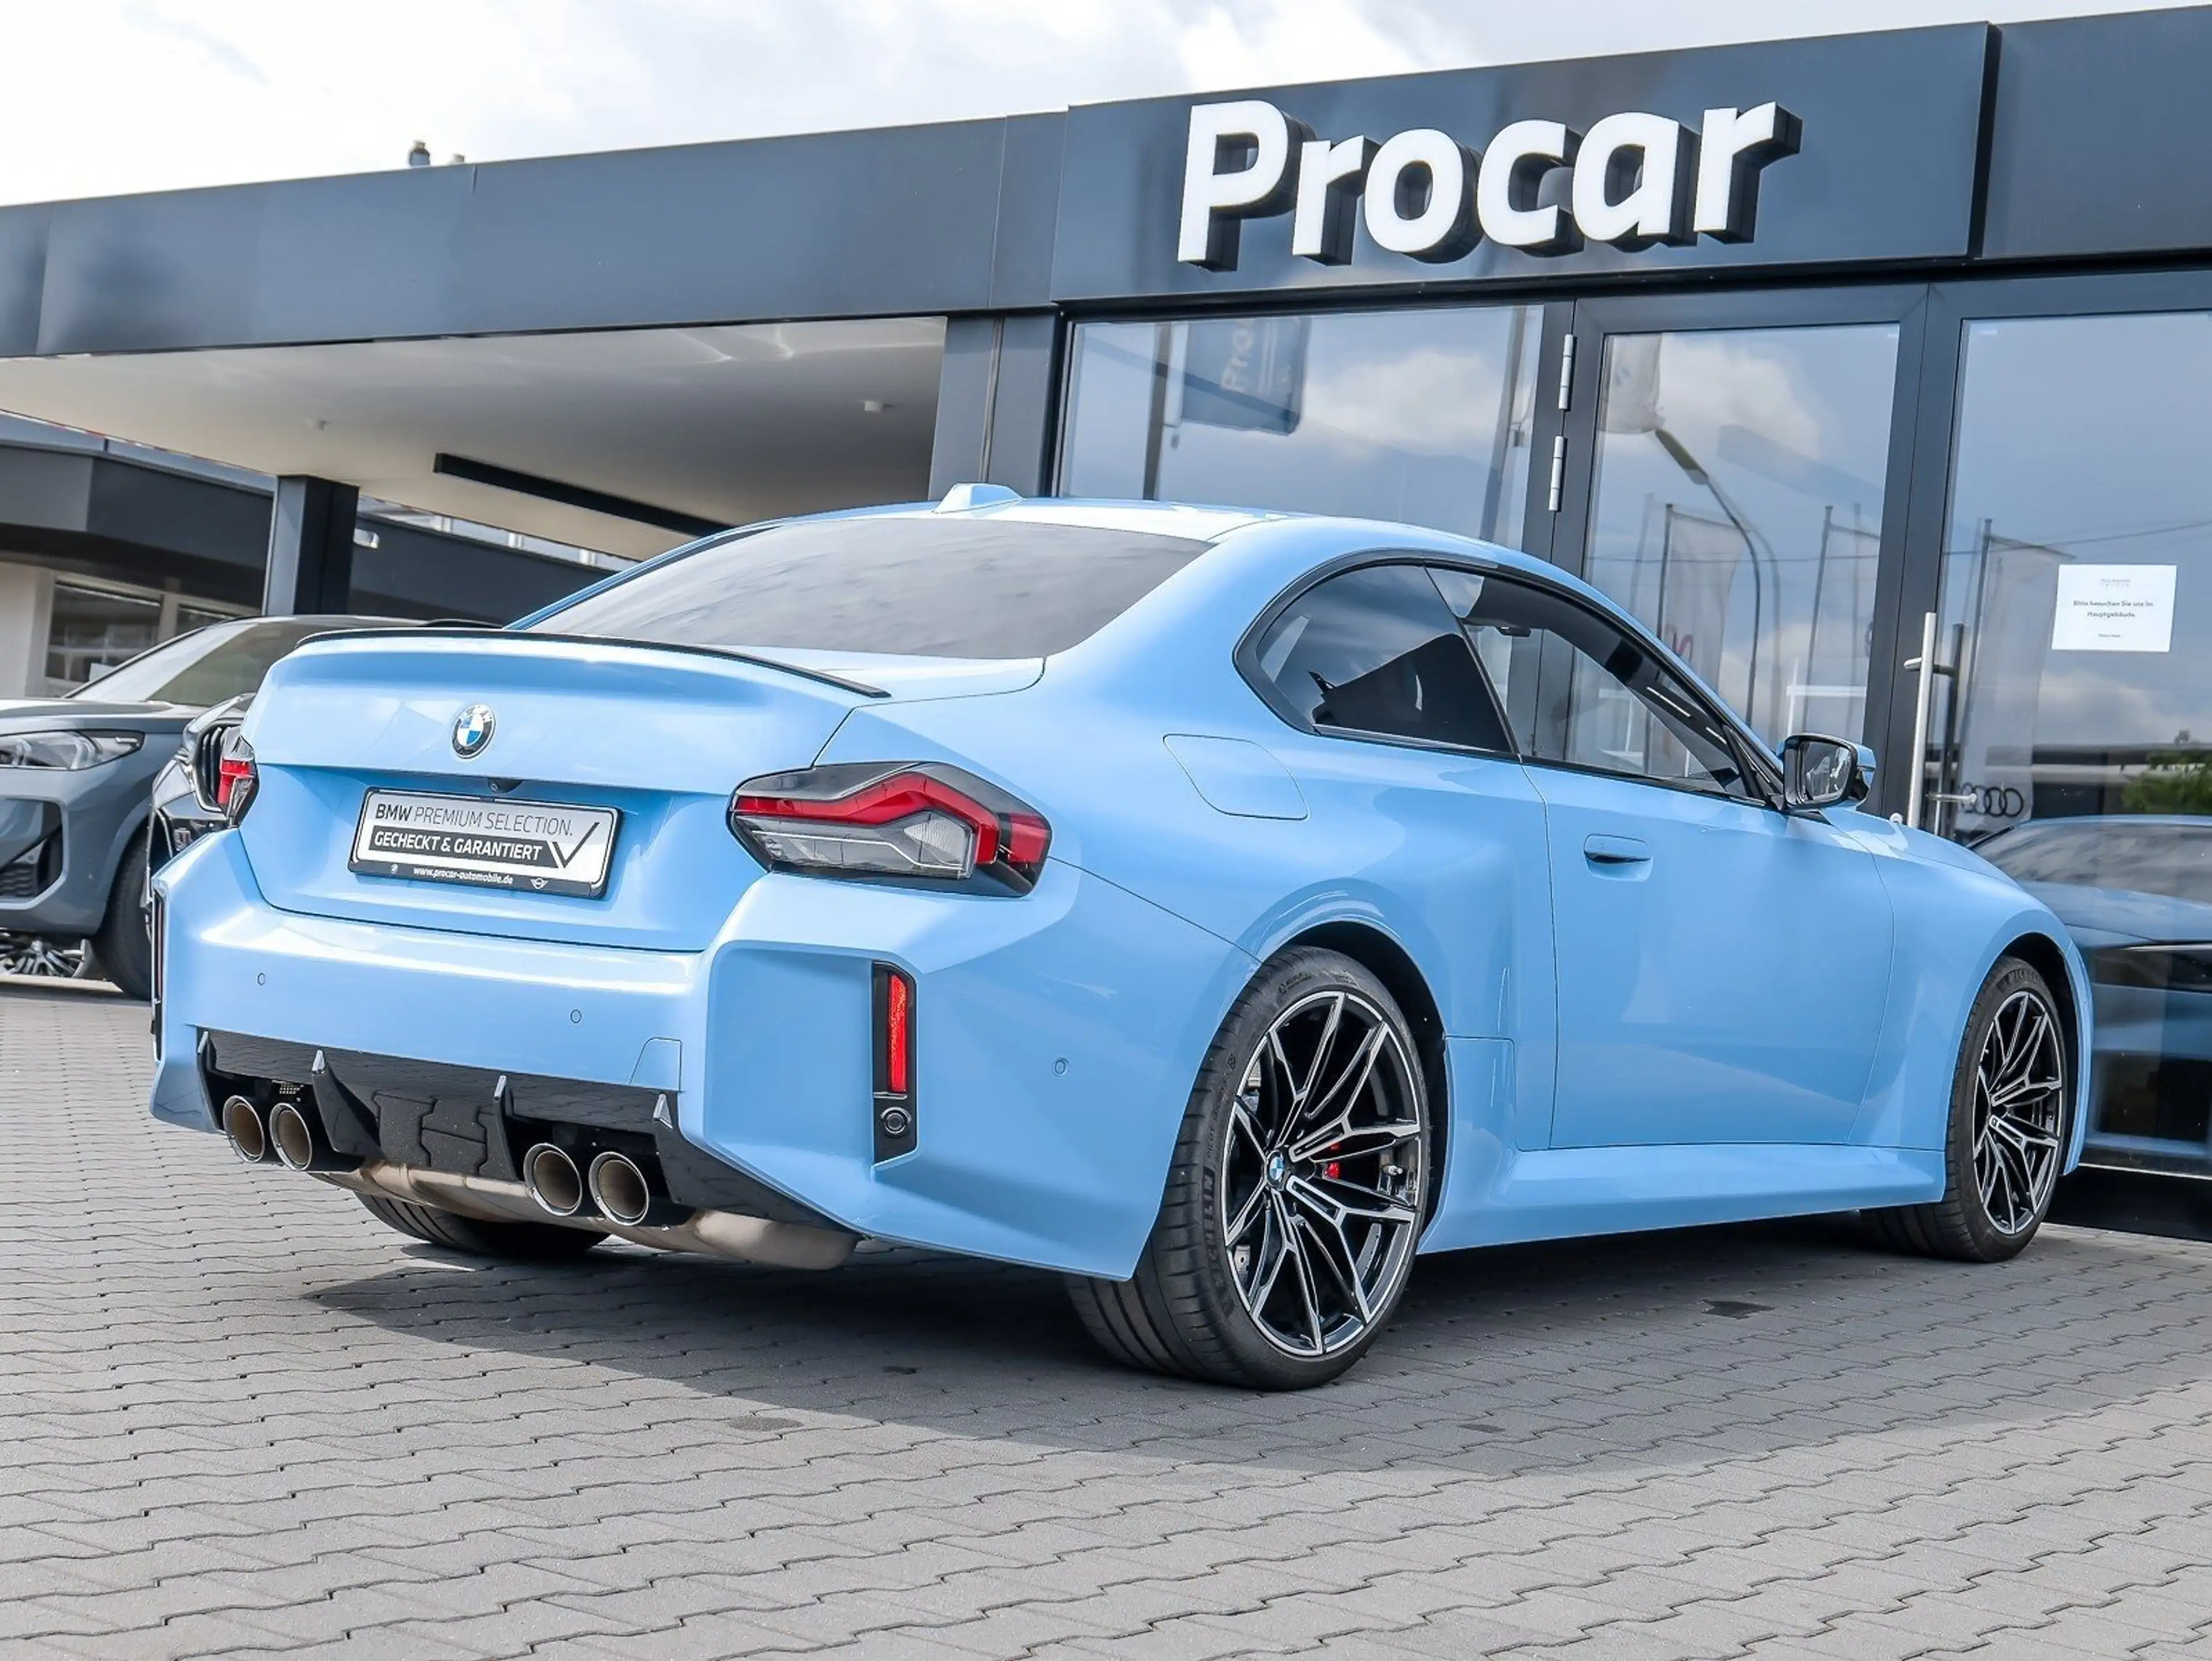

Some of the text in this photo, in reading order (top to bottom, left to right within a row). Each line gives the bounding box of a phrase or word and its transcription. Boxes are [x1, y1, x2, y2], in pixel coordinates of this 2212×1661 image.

[1177, 100, 1778, 264] Procar
[375, 803, 572, 836] BMW PREMIUM SELECTION.
[375, 830, 543, 861] GECHECKT & GARANTIERT
[414, 867, 513, 885] www.procar-automobile.de
